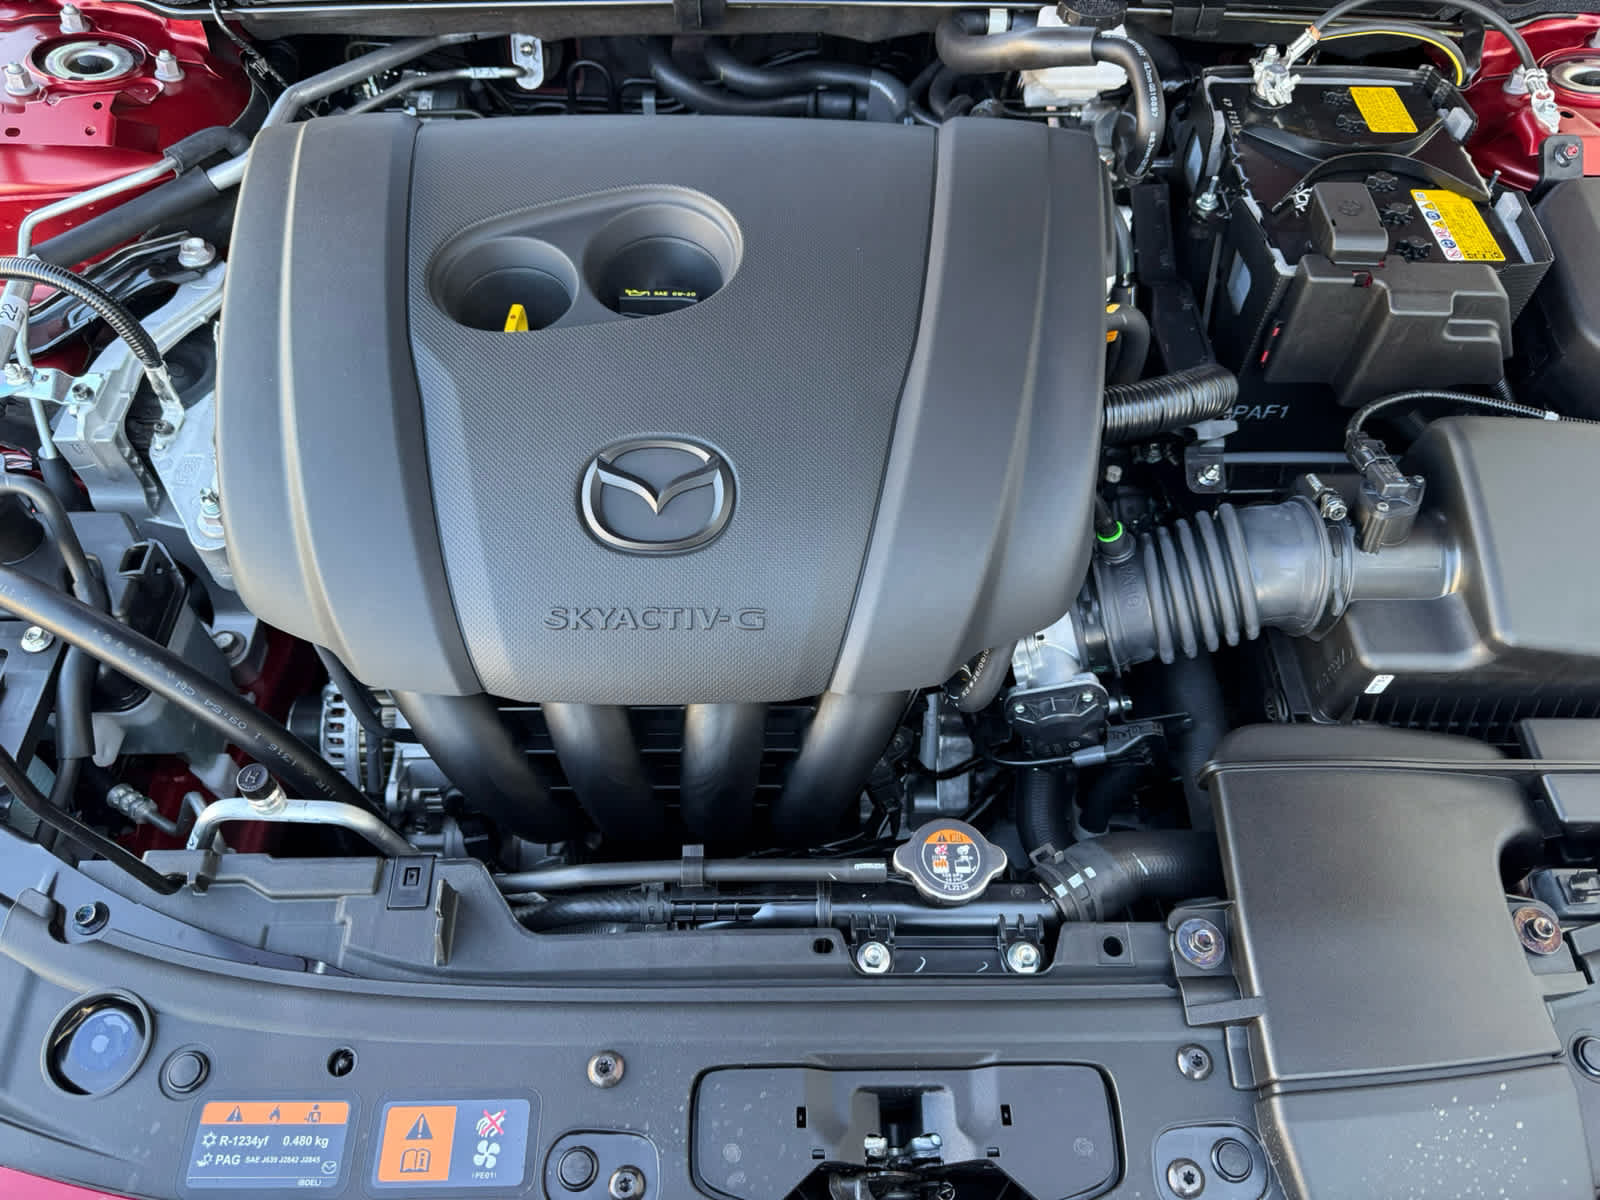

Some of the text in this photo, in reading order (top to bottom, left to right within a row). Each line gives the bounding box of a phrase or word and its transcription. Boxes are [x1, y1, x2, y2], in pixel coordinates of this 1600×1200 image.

[1231, 404, 1289, 419] PAF1
[543, 607, 767, 631] SKYACTIV-G
[219, 1134, 329, 1149] R-1234yf 0.480 kg
[215, 1154, 241, 1165] PAG
[244, 1155, 260, 1164] SAE
